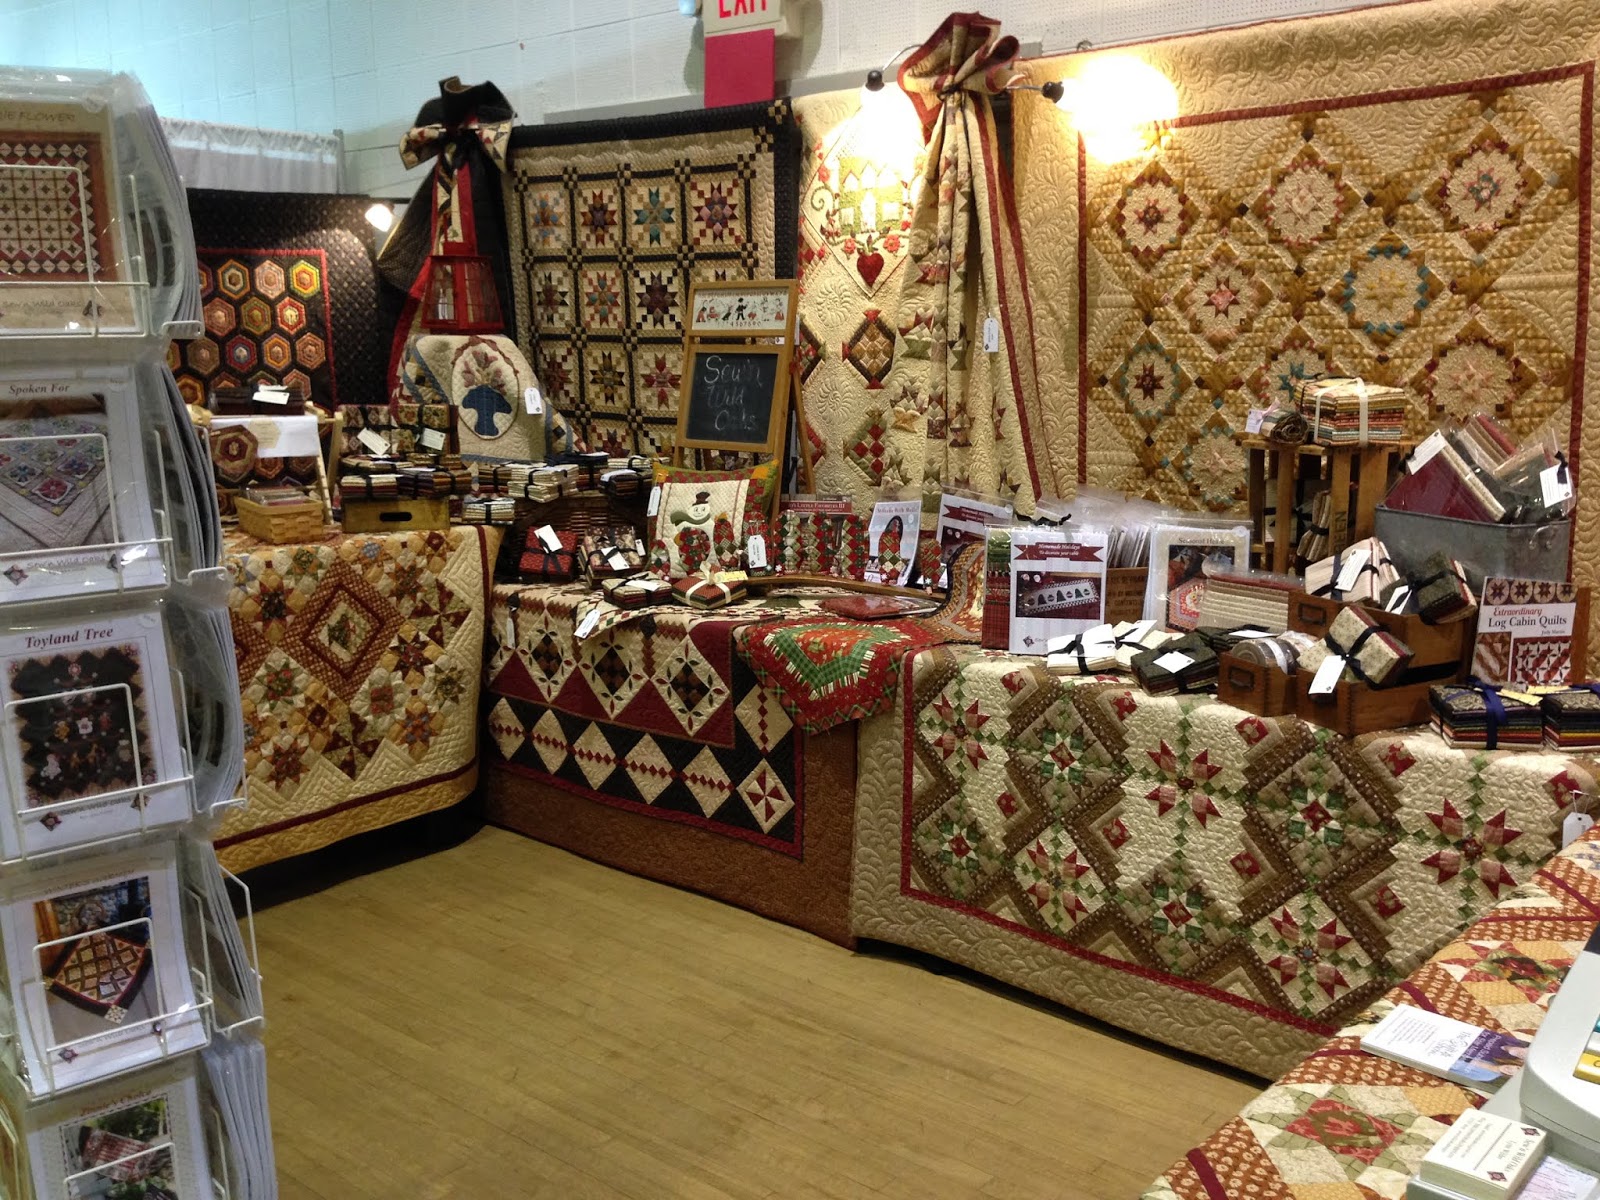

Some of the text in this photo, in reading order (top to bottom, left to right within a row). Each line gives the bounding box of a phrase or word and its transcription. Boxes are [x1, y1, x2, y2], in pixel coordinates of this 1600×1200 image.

[9, 383, 70, 396] Spoken For
[1493, 606, 1543, 617] Extraordinary
[1488, 615, 1567, 630] Log Cabin Quilts
[25, 626, 114, 650] Toyland Tree
